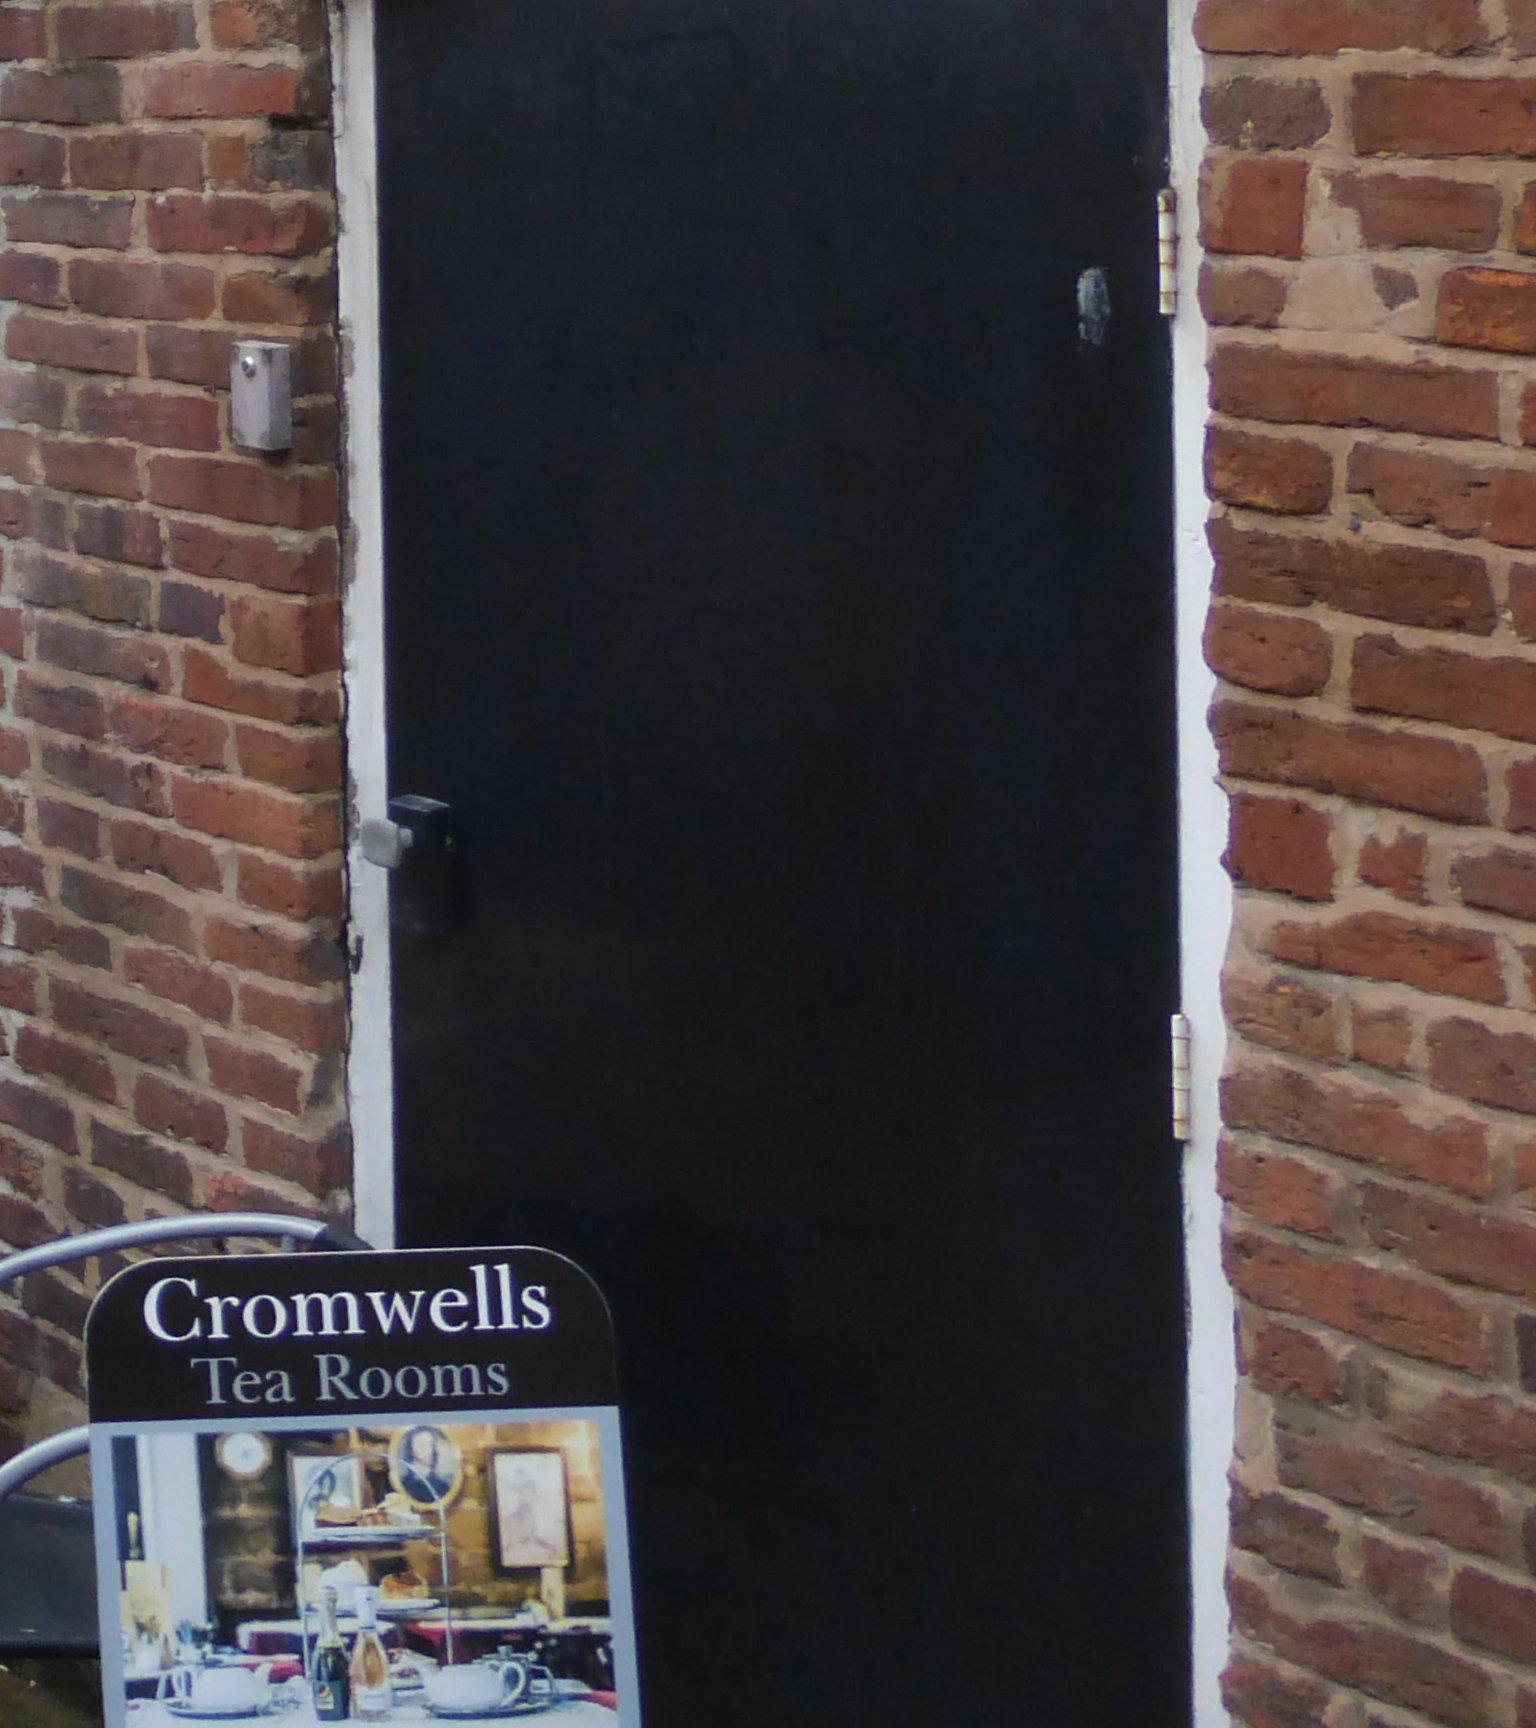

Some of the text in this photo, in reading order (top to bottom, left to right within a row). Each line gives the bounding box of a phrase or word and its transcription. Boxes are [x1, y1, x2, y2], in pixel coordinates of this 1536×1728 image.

[142, 1263, 553, 1343] Cromwells
[190, 1352, 510, 1406] Tea Rooms
